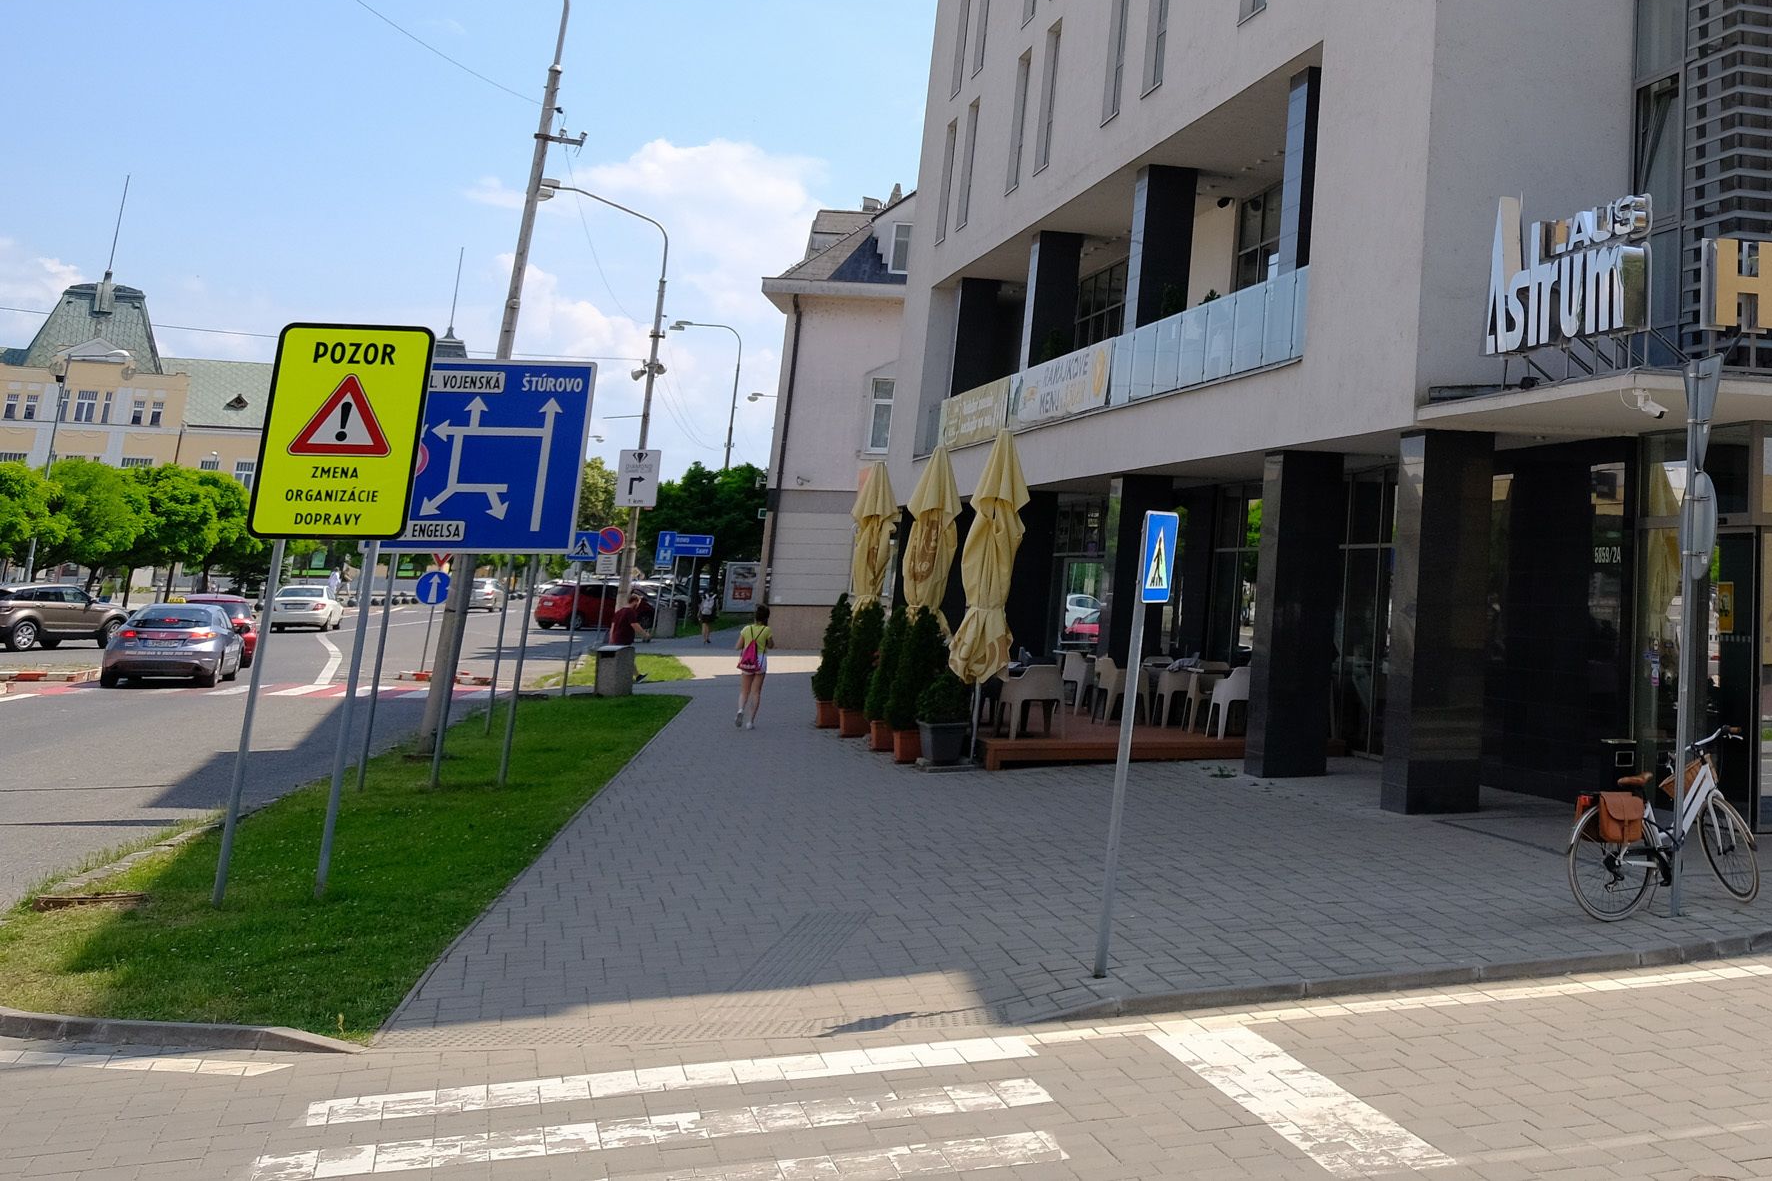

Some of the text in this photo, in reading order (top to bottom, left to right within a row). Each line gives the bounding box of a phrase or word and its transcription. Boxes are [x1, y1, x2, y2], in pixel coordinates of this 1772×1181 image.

[312, 341, 396, 365] POZOR
[442, 373, 501, 390] VOJENSKÁ
[521, 373, 583, 393] ŠTÚROVO
[311, 466, 359, 479] ZMENA
[285, 487, 379, 503] ORGANIZÁCIE
[294, 512, 362, 526] DOPRAVY
[412, 523, 460, 538] ENGELSA
